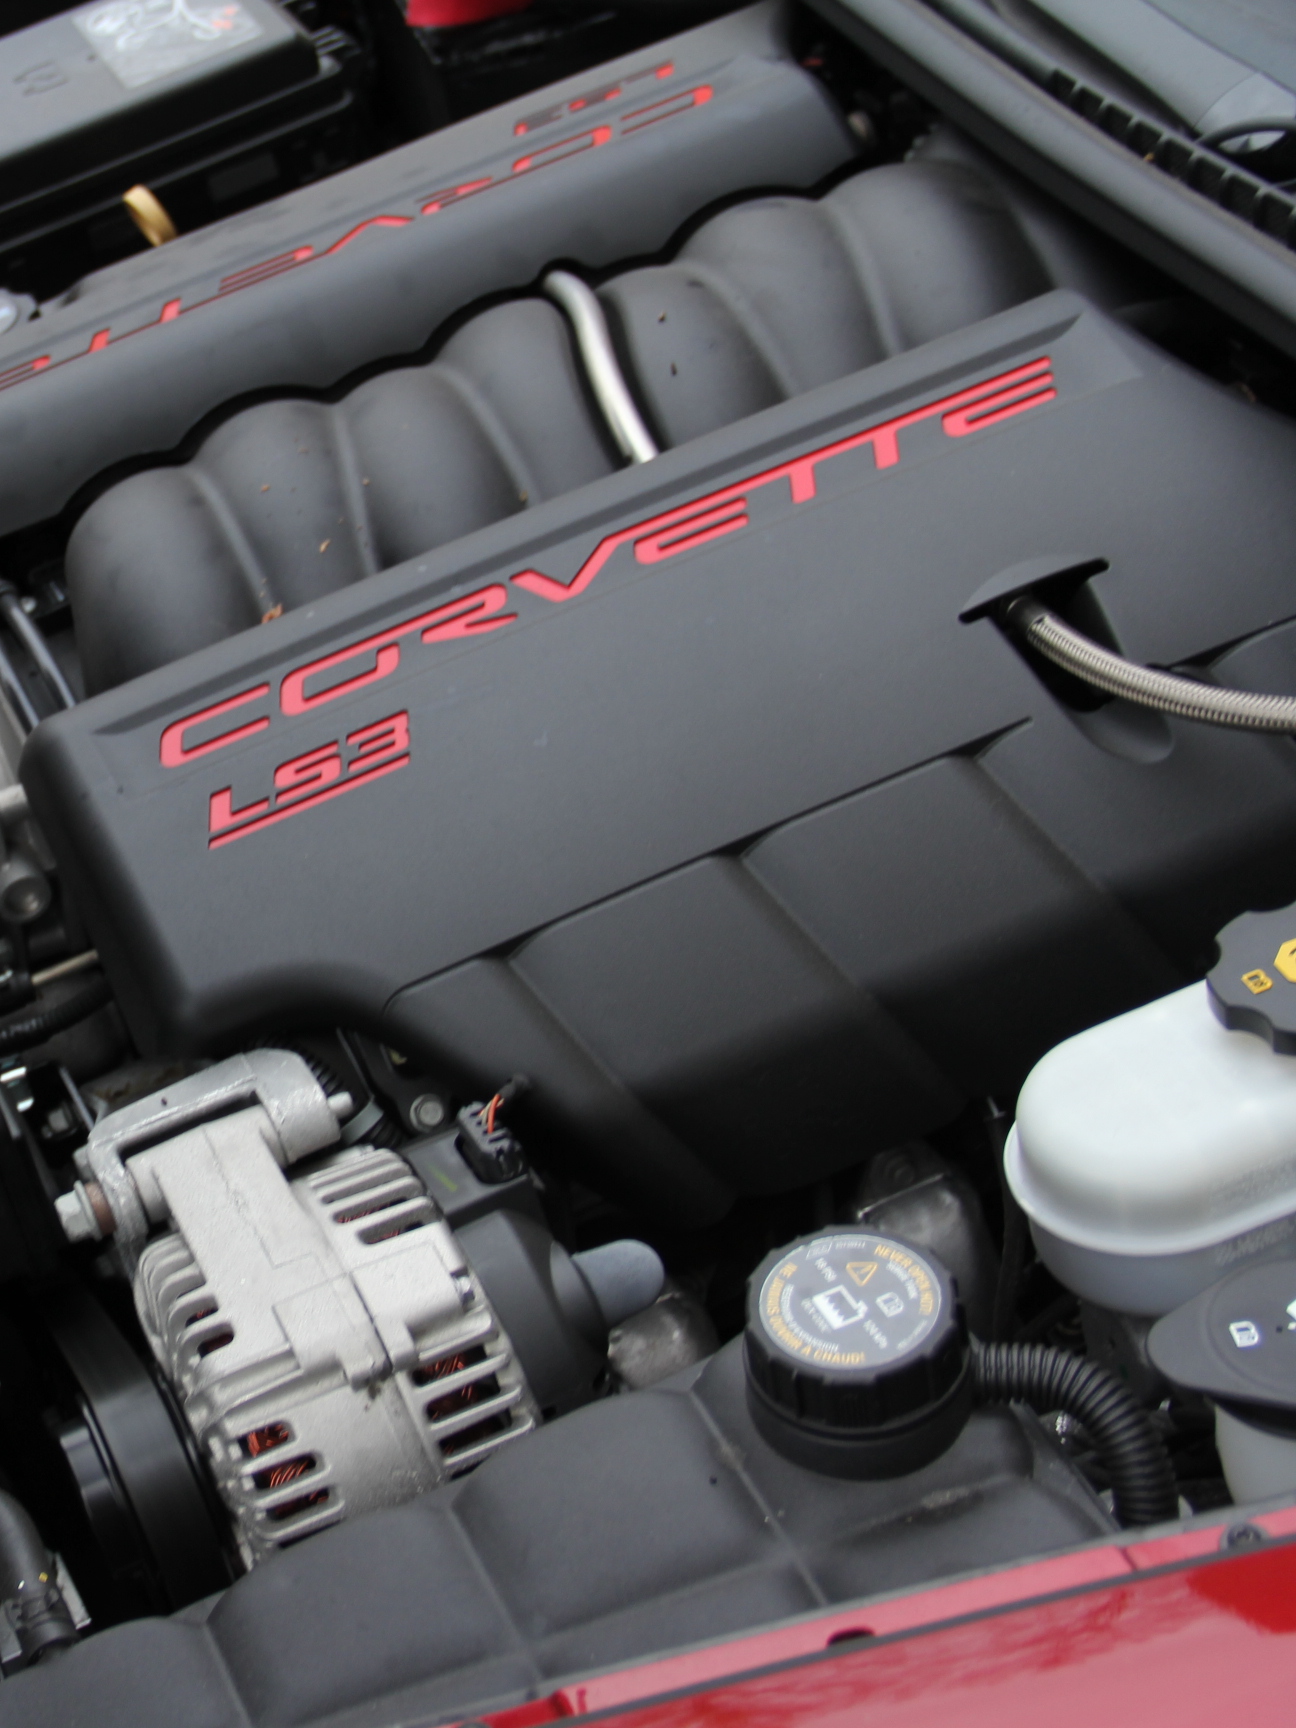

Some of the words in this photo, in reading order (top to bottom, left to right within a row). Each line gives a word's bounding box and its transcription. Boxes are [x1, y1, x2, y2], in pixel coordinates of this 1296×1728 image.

[159, 355, 1057, 769] CORVETTE
[208, 709, 410, 838] LS3
[874, 1244, 913, 1268] NEVER
